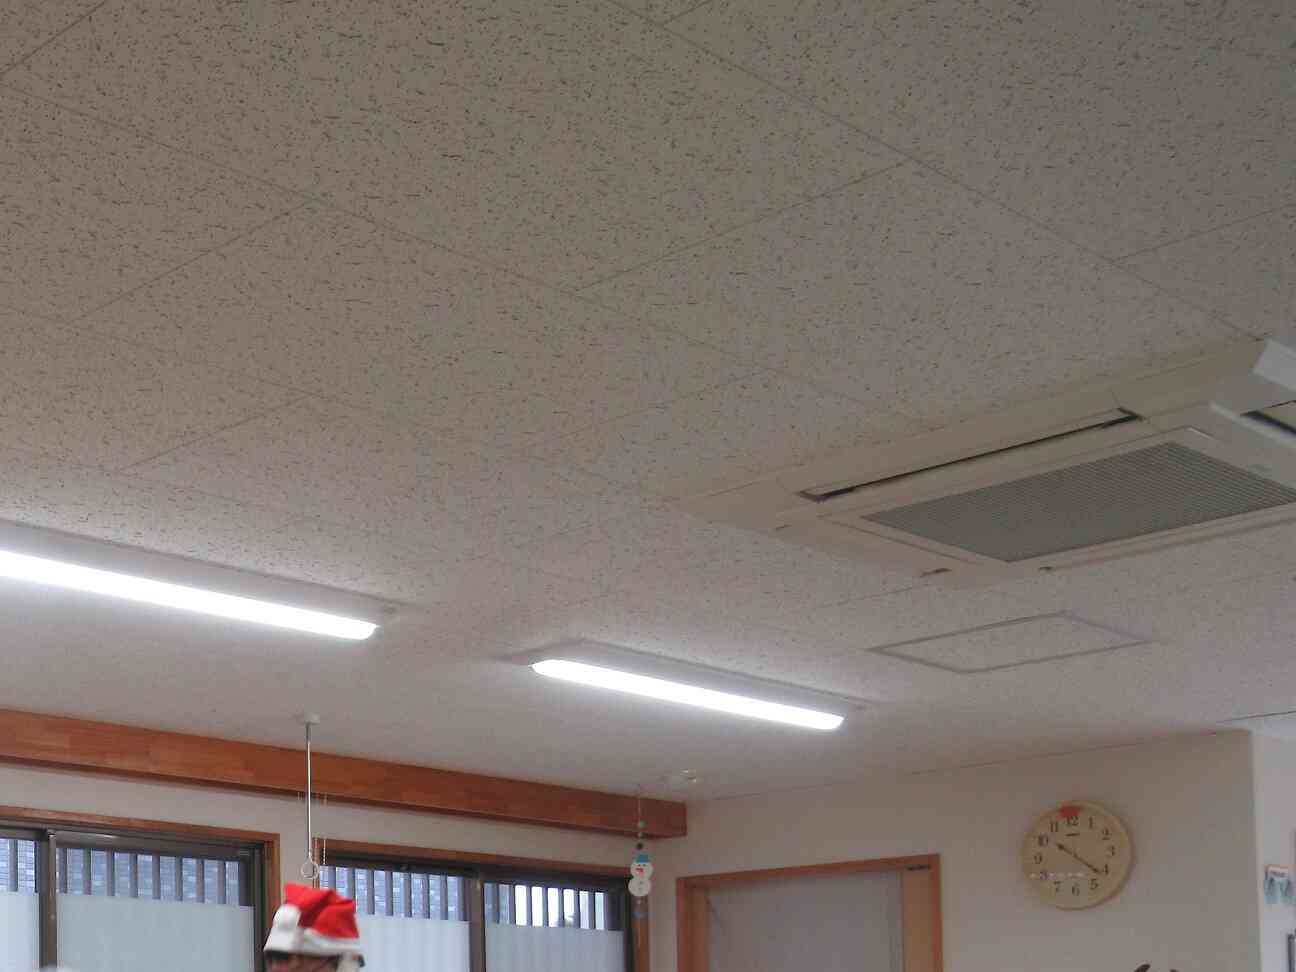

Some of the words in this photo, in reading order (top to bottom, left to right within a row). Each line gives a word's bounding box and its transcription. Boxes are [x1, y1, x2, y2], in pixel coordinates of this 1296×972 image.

[1101, 827, 1111, 841] 2
[1037, 834, 1050, 848] 10
[1106, 844, 1116, 857] 3
[1053, 880, 1063, 893] 7
[1071, 882, 1081, 897] 6
[1090, 878, 1100, 891] 5
